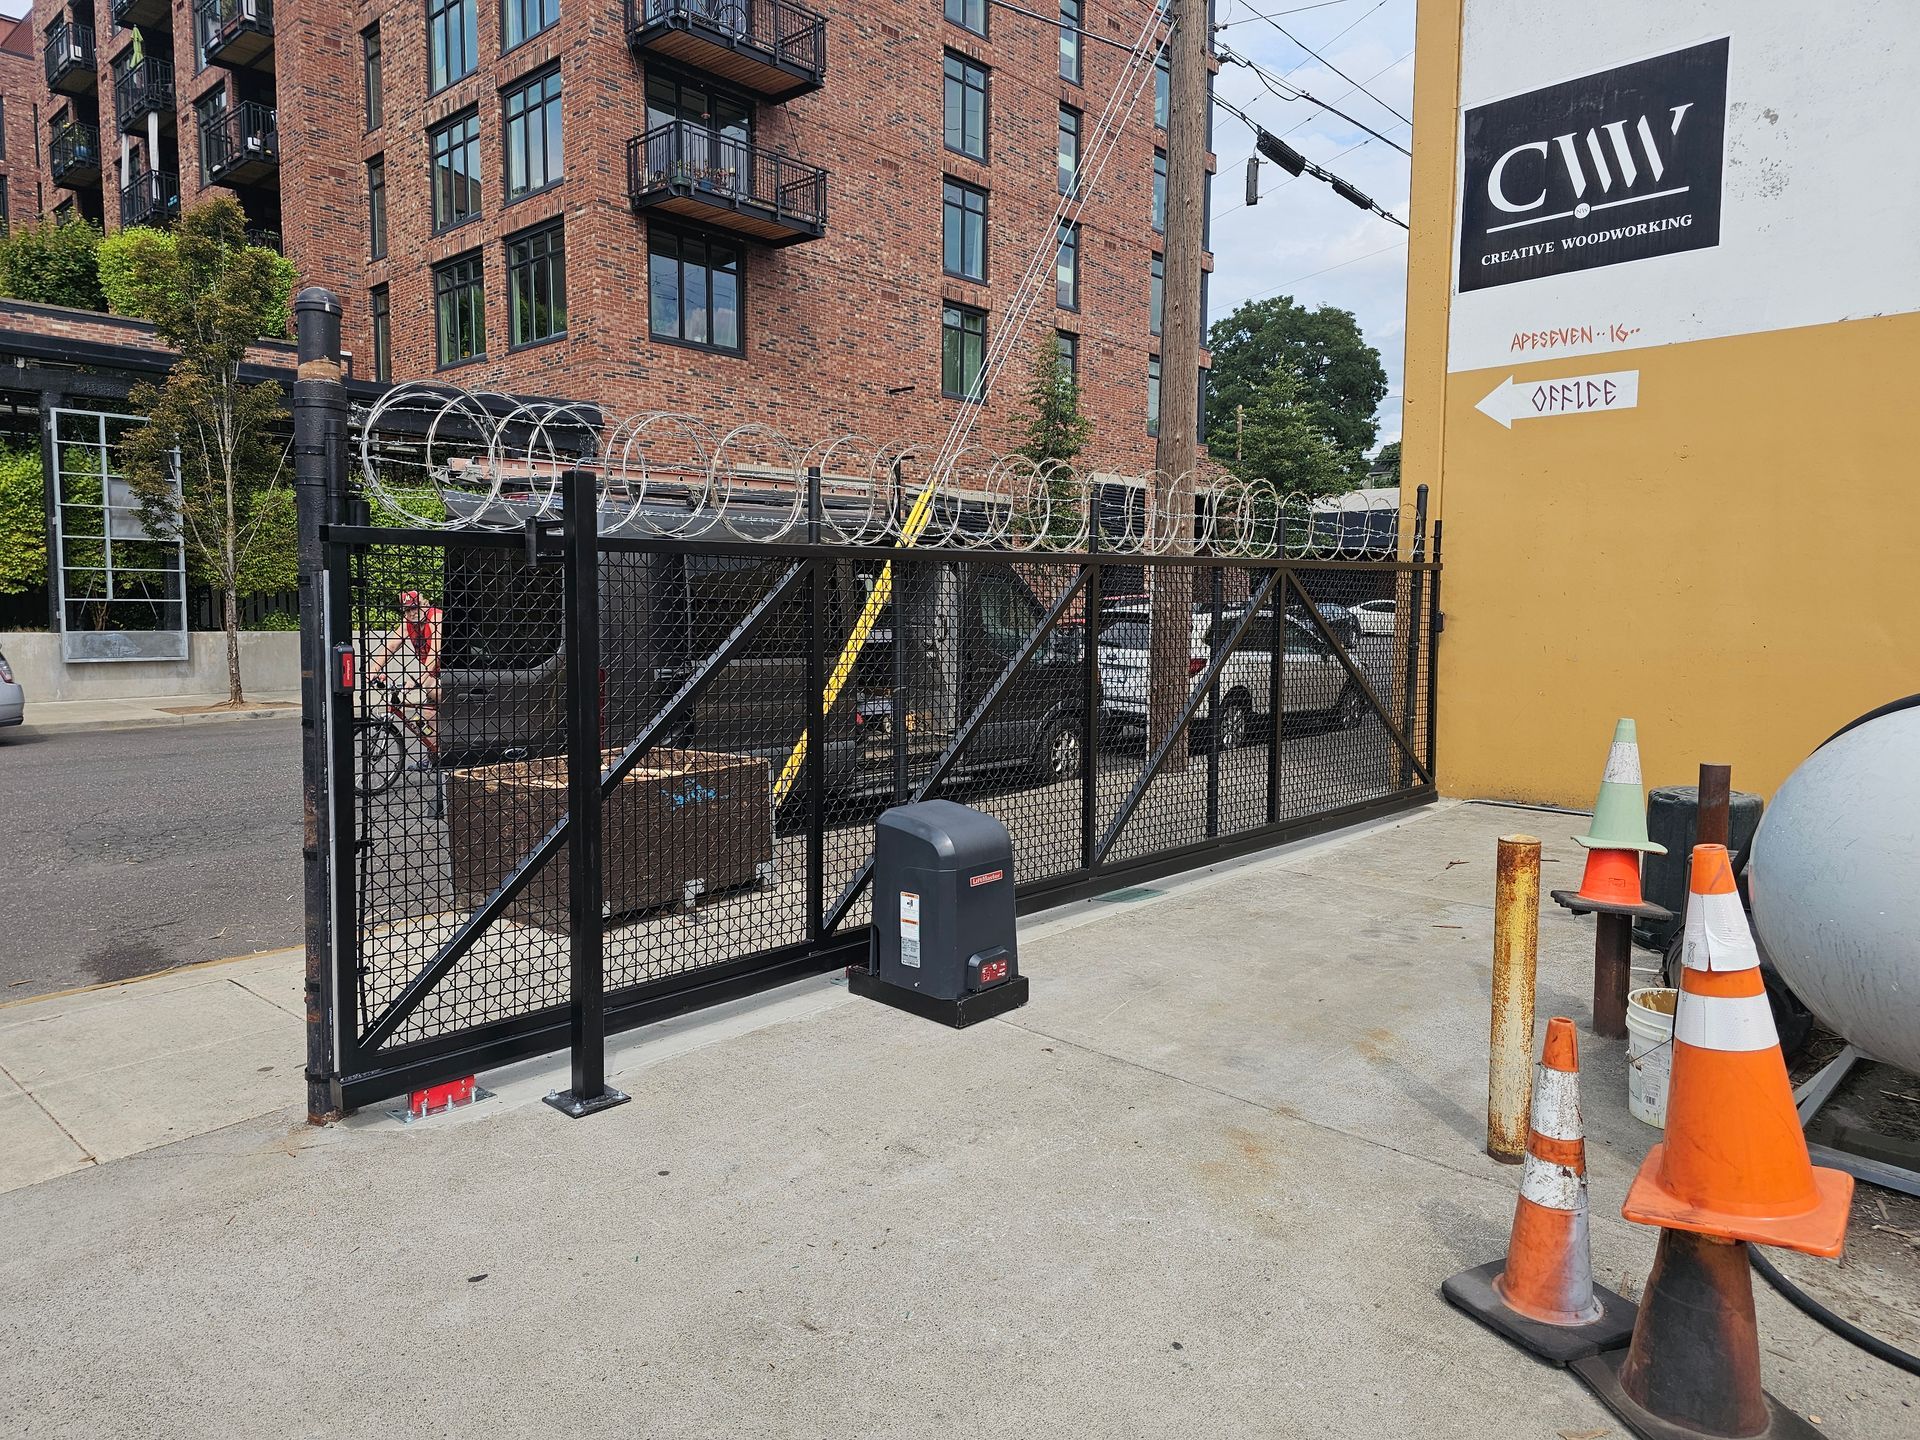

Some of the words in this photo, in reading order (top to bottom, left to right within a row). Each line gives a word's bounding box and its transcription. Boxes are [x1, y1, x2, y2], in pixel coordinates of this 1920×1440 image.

[1481, 241, 1555, 266] CREATIVE
[1561, 214, 1693, 250] WOODWORKING
[1531, 379, 1617, 412] OFFICE
[972, 873, 1001, 885] LiftMaster
